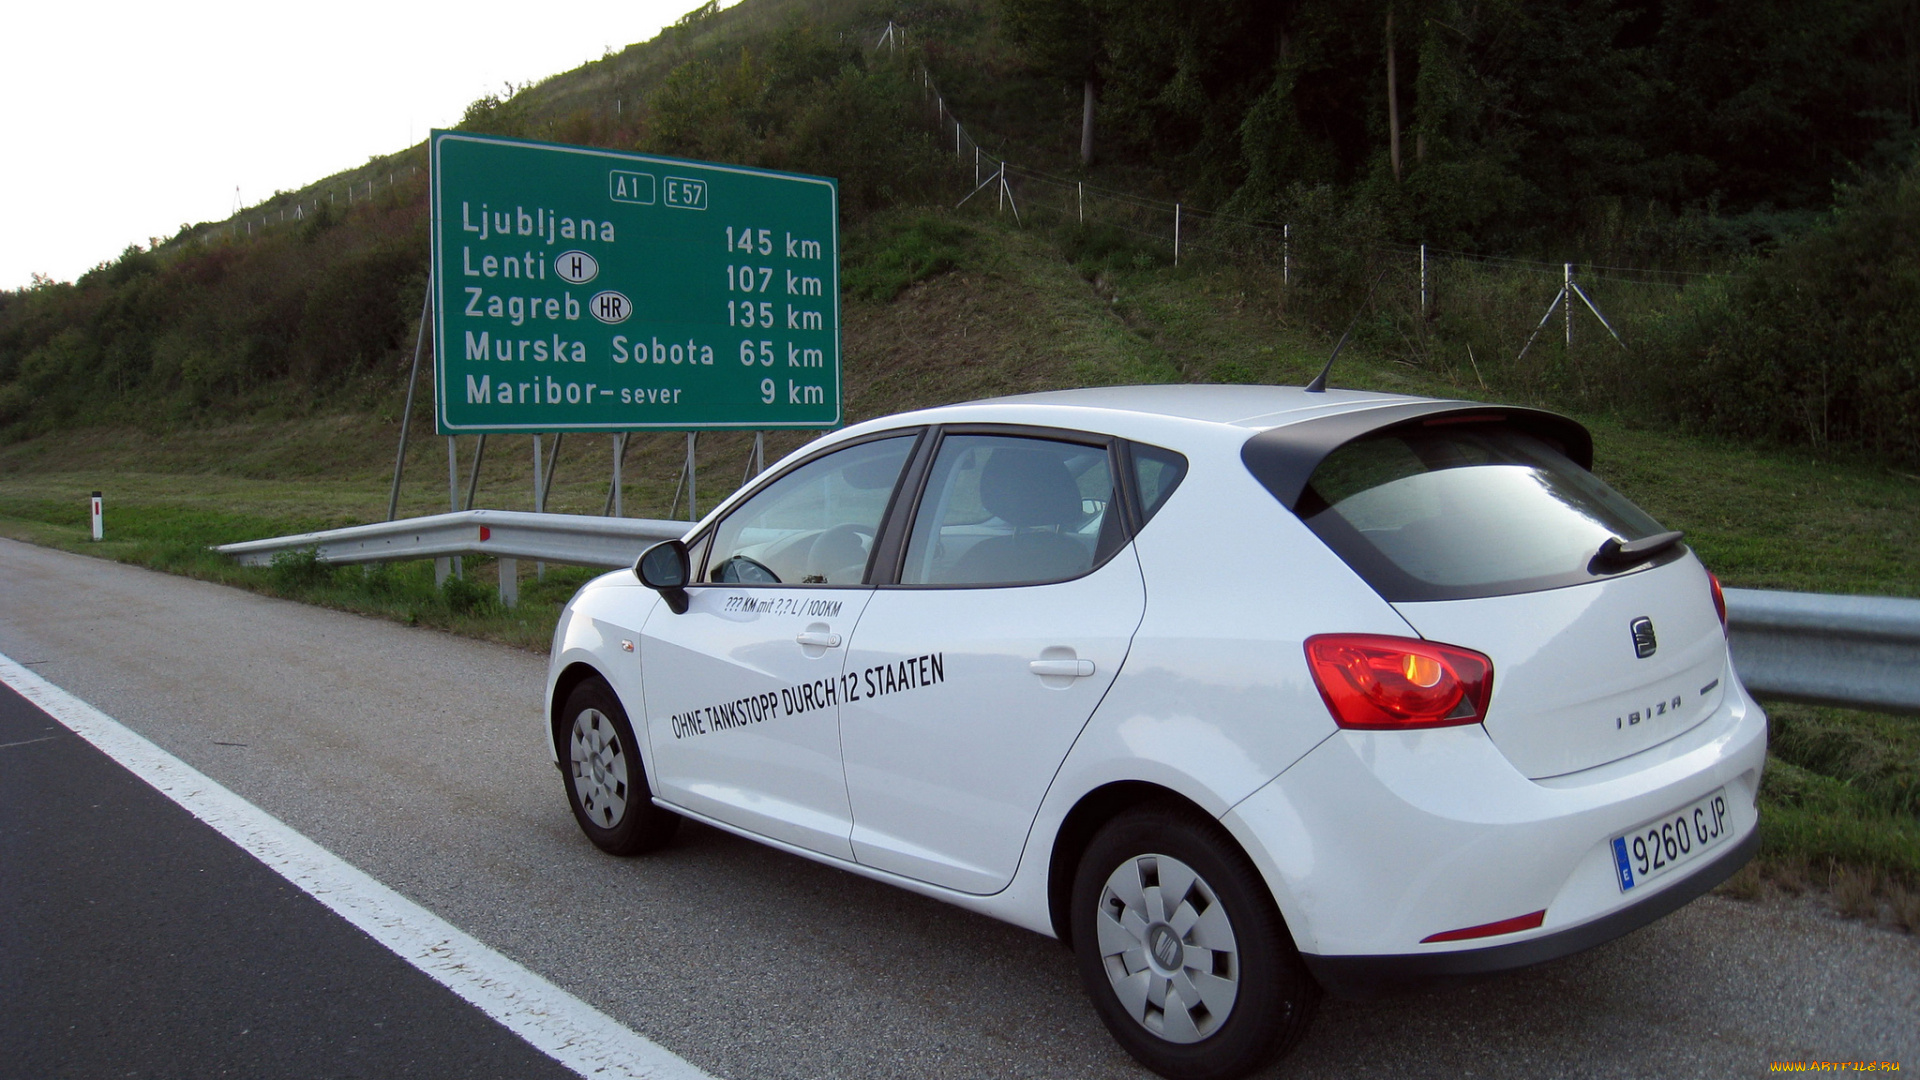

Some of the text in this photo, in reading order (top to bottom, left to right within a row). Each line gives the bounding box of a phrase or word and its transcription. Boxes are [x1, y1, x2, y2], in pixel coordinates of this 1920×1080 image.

[462, 201, 615, 244] Ljubljana
[726, 226, 822, 260] 145 km
[463, 246, 545, 280] Lenti
[571, 256, 582, 279] H
[726, 265, 822, 296] 107 km
[464, 287, 581, 326] Zagreb
[600, 297, 622, 317] HR
[727, 301, 823, 330] 135 km
[465, 331, 715, 365] Murska Sobota
[739, 340, 823, 368] 65 km
[761, 379, 824, 404] 9 km
[741, 597, 758, 612] KM
[756, 598, 775, 613] mit
[671, 652, 945, 739] OHNE TANKSTOPP DURCH 12 STAATEN
[1616, 695, 1682, 730] IBIZA
[1632, 796, 1725, 875] 9260 GJP
[1623, 869, 1630, 881] E
